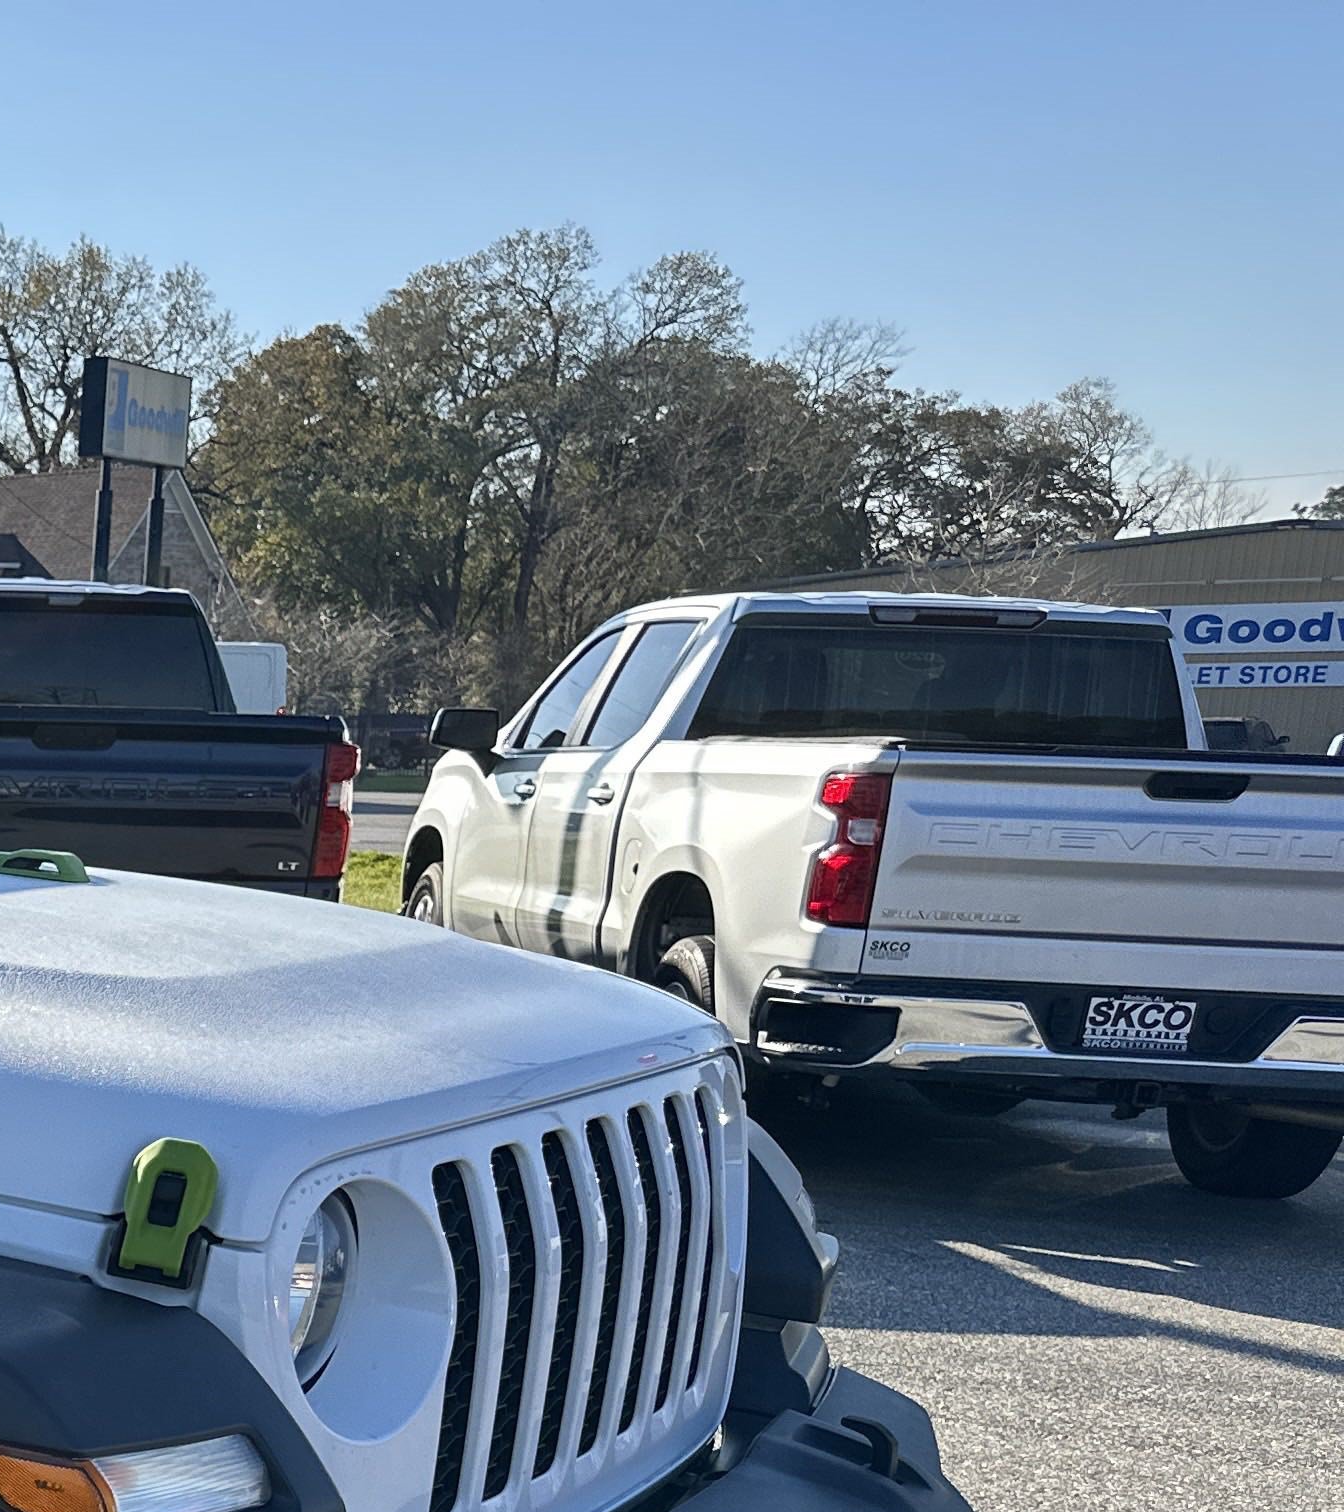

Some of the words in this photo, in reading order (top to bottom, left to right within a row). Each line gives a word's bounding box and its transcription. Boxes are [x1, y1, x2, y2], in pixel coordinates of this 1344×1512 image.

[1191, 665, 1230, 684] ET
[1239, 665, 1328, 684] STORE
[928, 822, 1344, 861] CHEVROL
[277, 861, 300, 872] LT
[870, 940, 911, 952] SKCO
[1089, 1000, 1192, 1031] SKCO
[1085, 1028, 1188, 1040] AUTOMOTIVE
